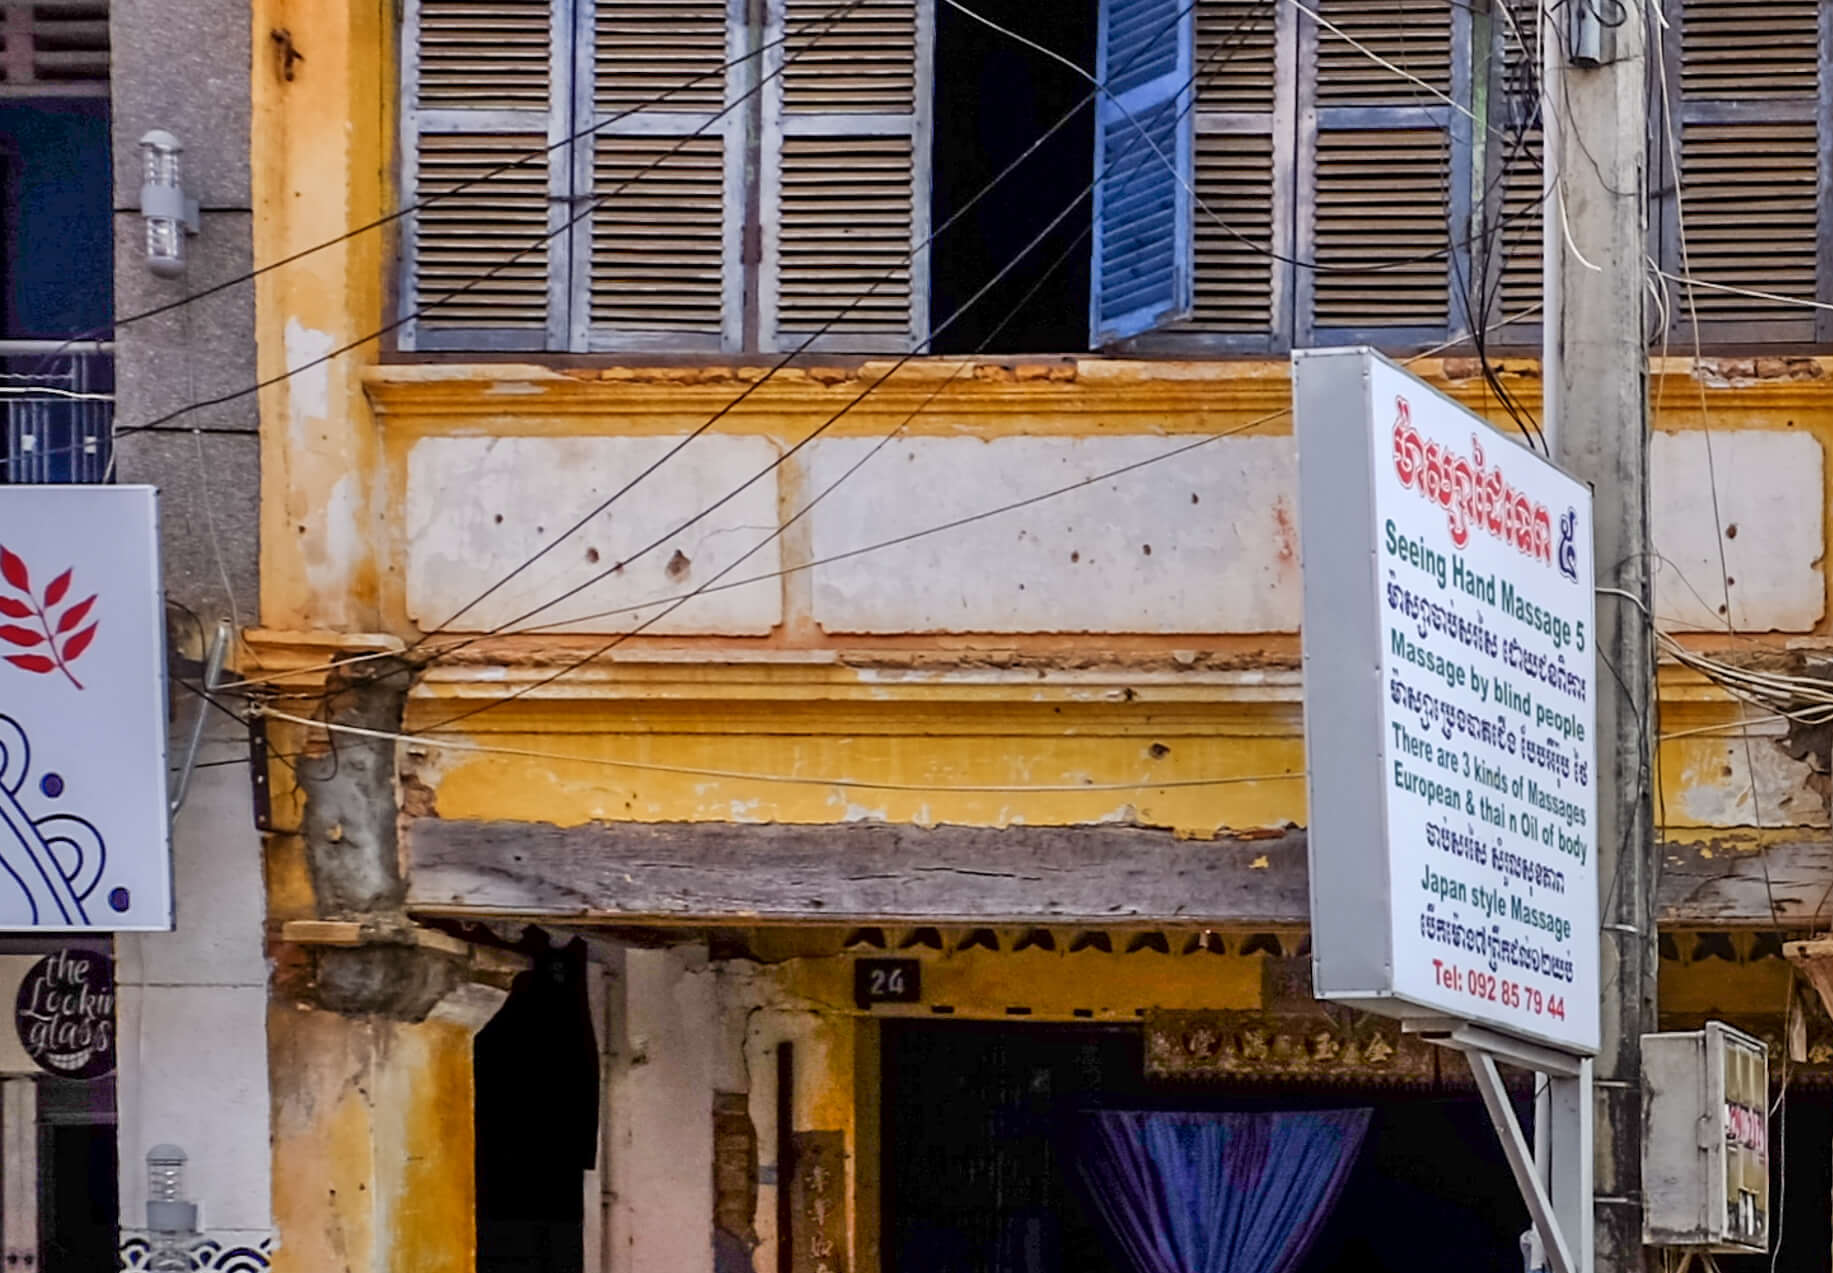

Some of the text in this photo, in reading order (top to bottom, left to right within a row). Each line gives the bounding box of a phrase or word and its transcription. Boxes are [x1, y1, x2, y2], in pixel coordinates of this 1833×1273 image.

[1386, 519, 1585, 652] Seeing Hand Massage 5
[1391, 628, 1585, 742] Massage by blind people
[1392, 721, 1587, 826] There are 3 kinds of Massages
[1394, 760, 1588, 866] European & thai n Oil of body
[1421, 864, 1571, 942] Japan style Massage
[46, 948, 90, 987] the
[1433, 958, 1565, 1021] Tel: 092 85 79 44
[29, 1012, 110, 1058] glass
